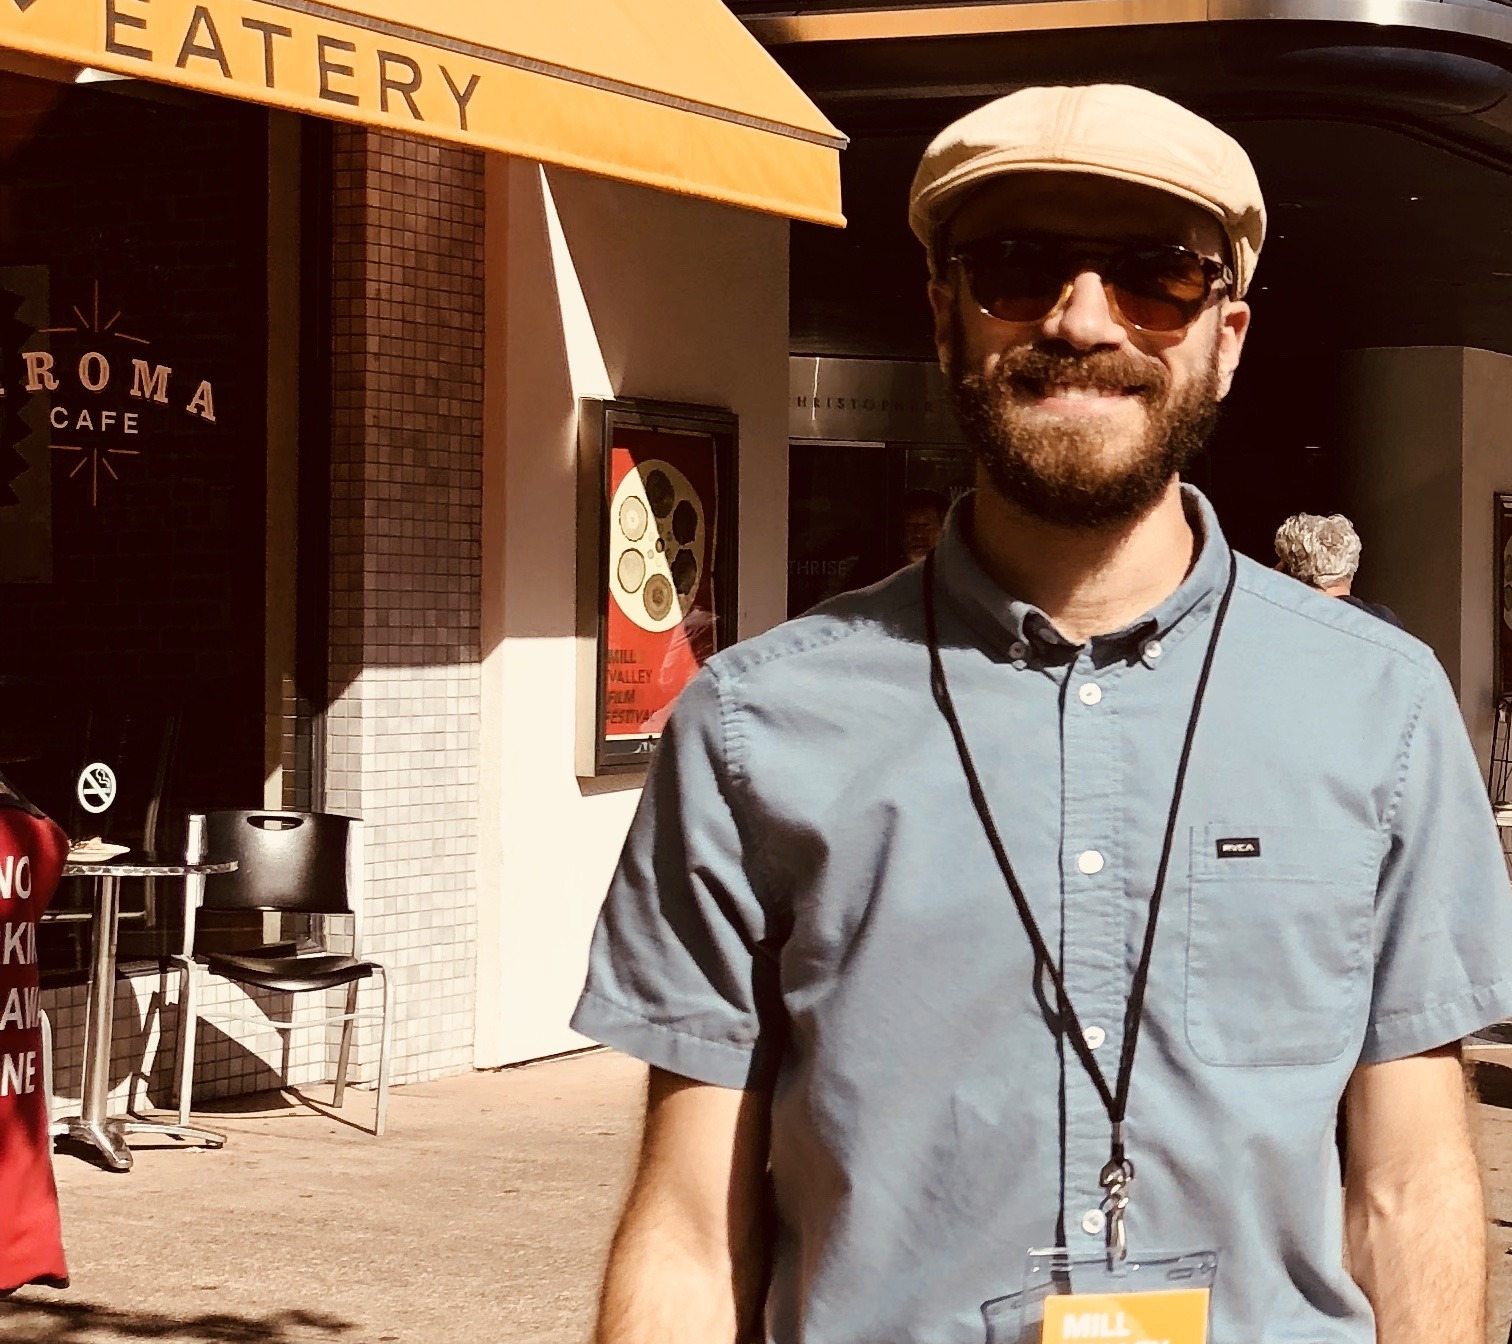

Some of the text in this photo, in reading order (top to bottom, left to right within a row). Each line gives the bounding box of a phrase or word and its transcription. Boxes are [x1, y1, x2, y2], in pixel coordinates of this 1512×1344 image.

[0, 351, 216, 423] ROMA
[50, 406, 139, 434] CAFE
[607, 669, 653, 684] VALLEY
[606, 709, 657, 724] FESTIVA
[1, 1051, 36, 1097] NE
[1061, 1311, 1132, 1340] MILL
